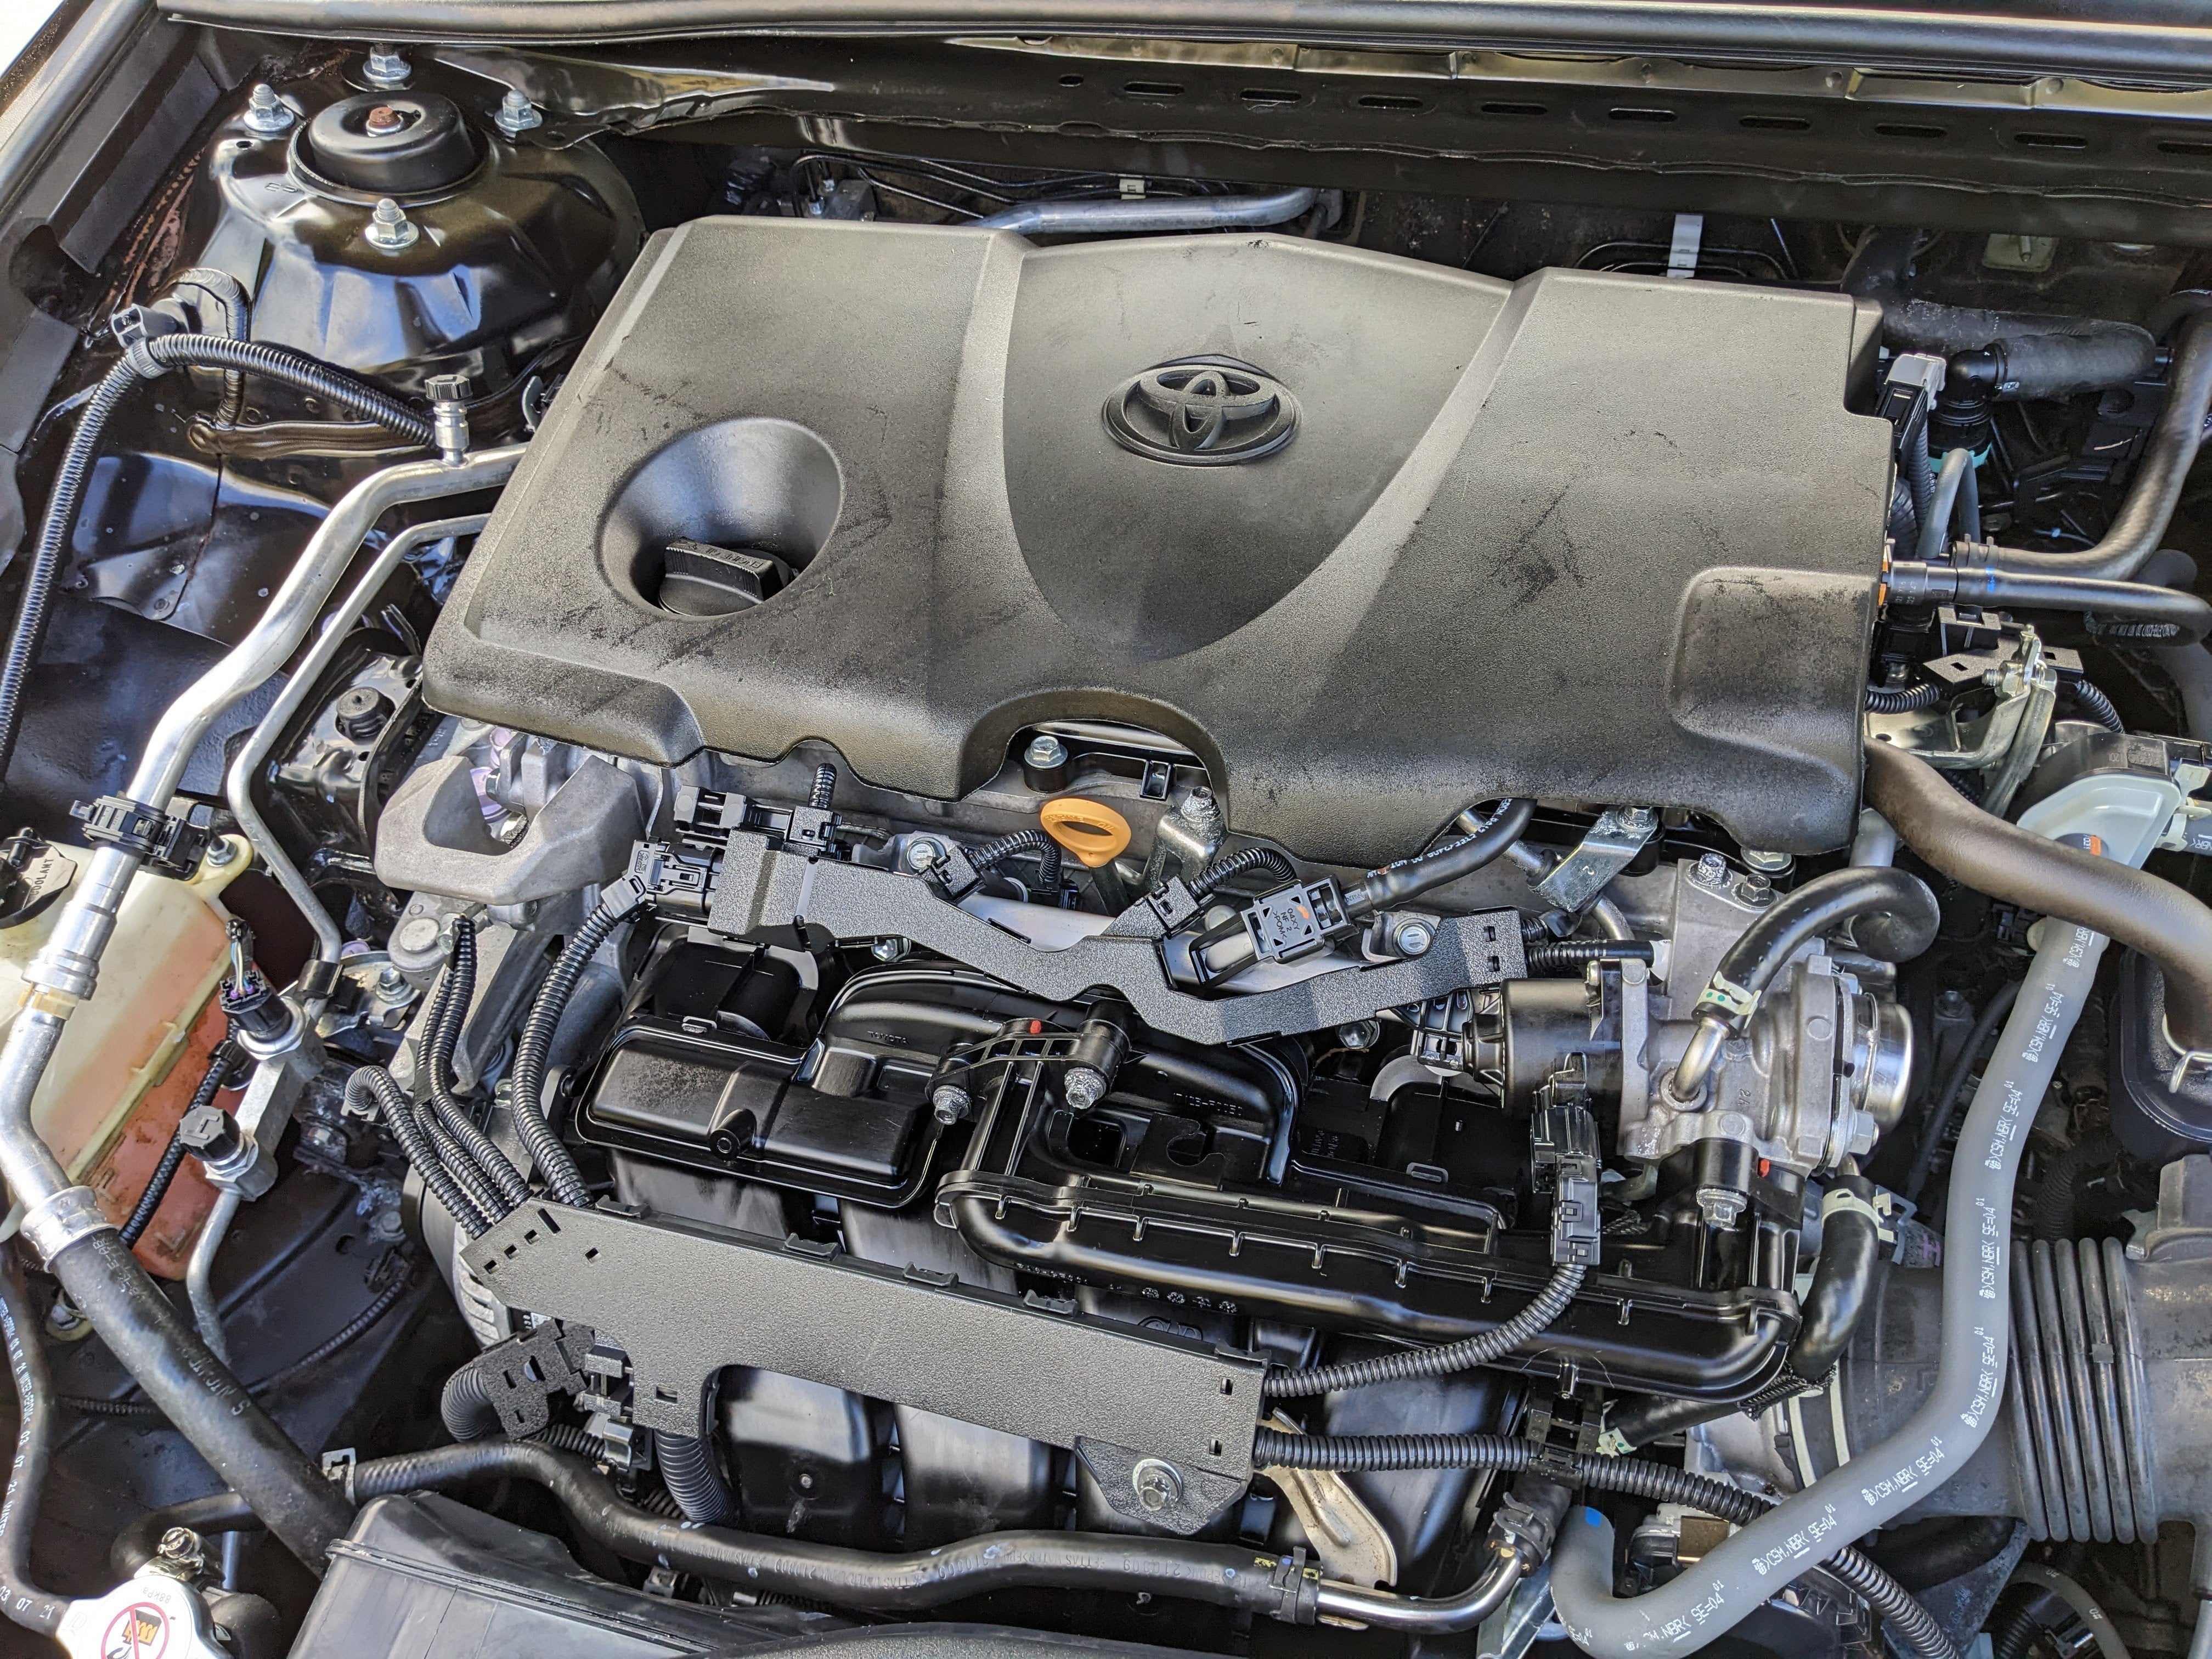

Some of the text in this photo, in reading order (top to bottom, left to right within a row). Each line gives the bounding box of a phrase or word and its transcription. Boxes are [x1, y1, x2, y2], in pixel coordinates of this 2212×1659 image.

[867, 1030, 909, 1044] TOYOTA
[143, 1587, 171, 1603] 88kPa
[15, 1597, 32, 1615] 07
[38, 1605, 55, 1620] 21
